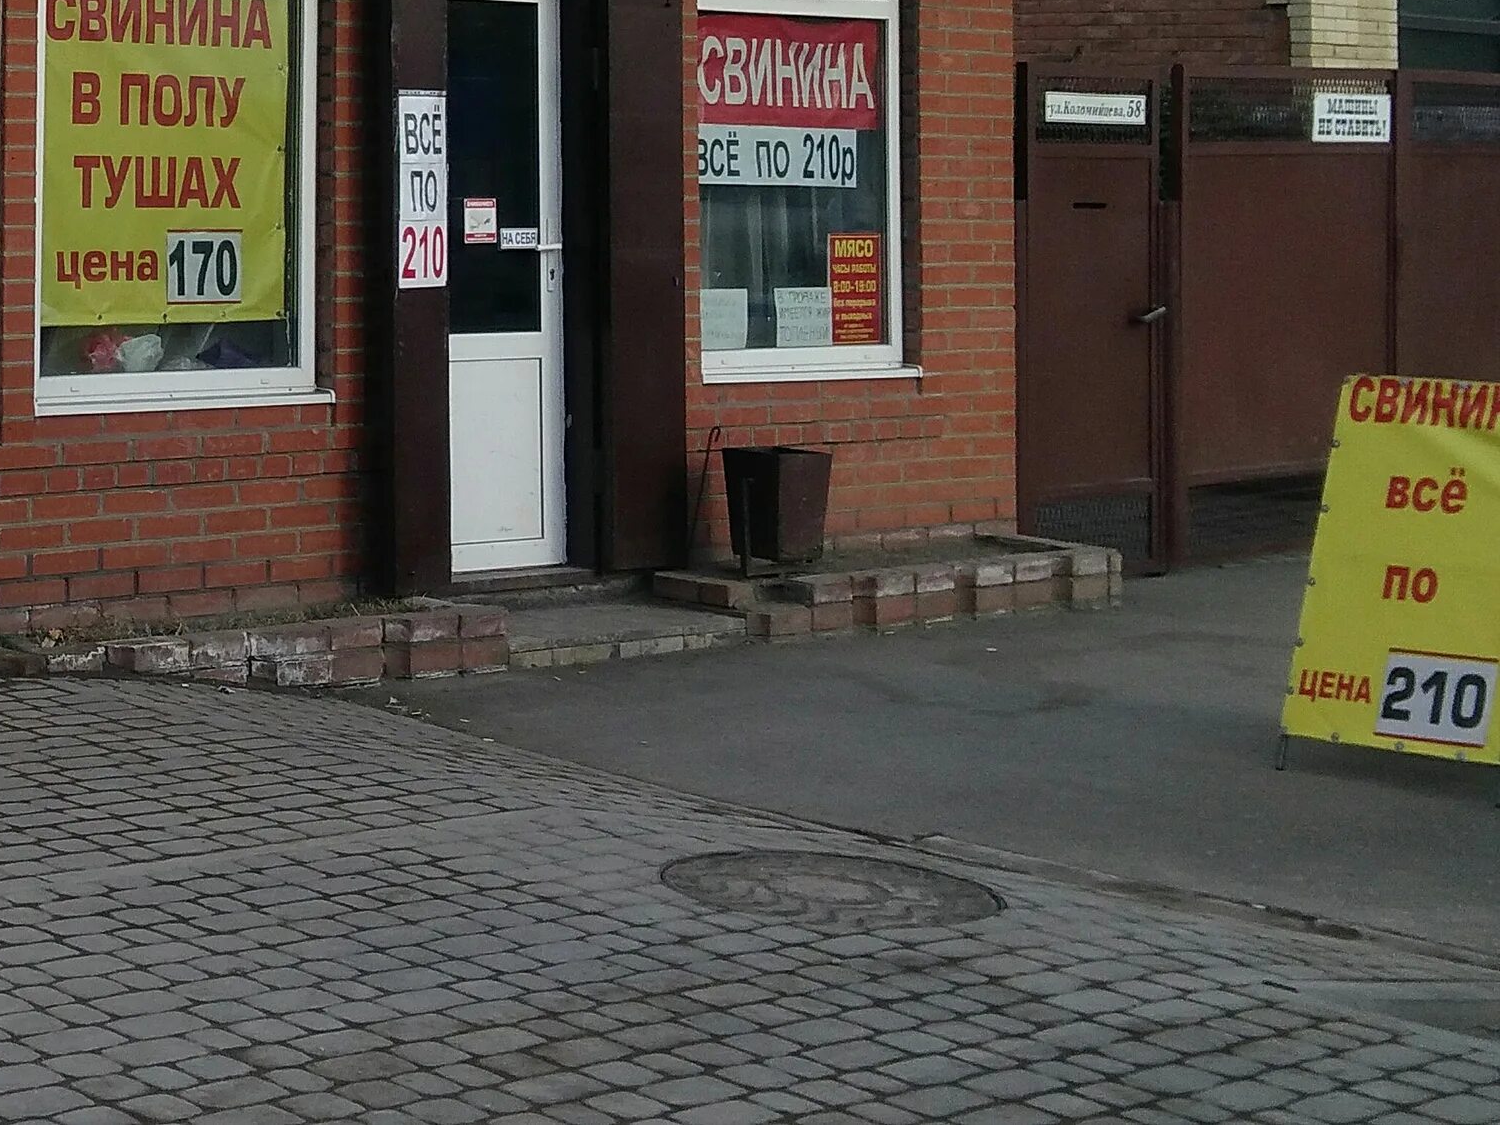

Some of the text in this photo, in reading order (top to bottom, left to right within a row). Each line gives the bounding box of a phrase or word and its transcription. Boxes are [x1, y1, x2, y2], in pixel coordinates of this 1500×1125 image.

[697, 36, 875, 109] СВИНИНА
[72, 71, 246, 128] В ПОЛУ
[1327, 98, 1378, 115] МАШИНЫ
[404, 105, 442, 155] ВСЁ
[1318, 118, 1332, 135] НЕ
[73, 155, 241, 208] ТУШАХ
[698, 131, 855, 185] ВСЁ ПО 210р
[410, 170, 437, 212] ПО
[402, 226, 444, 279] 210
[501, 232, 513, 244] НА
[515, 232, 536, 245] СЕБЯ
[834, 239, 873, 257] МЯСО
[56, 240, 237, 296] цена 170
[1298, 665, 1487, 729] ЦЕНА 210
